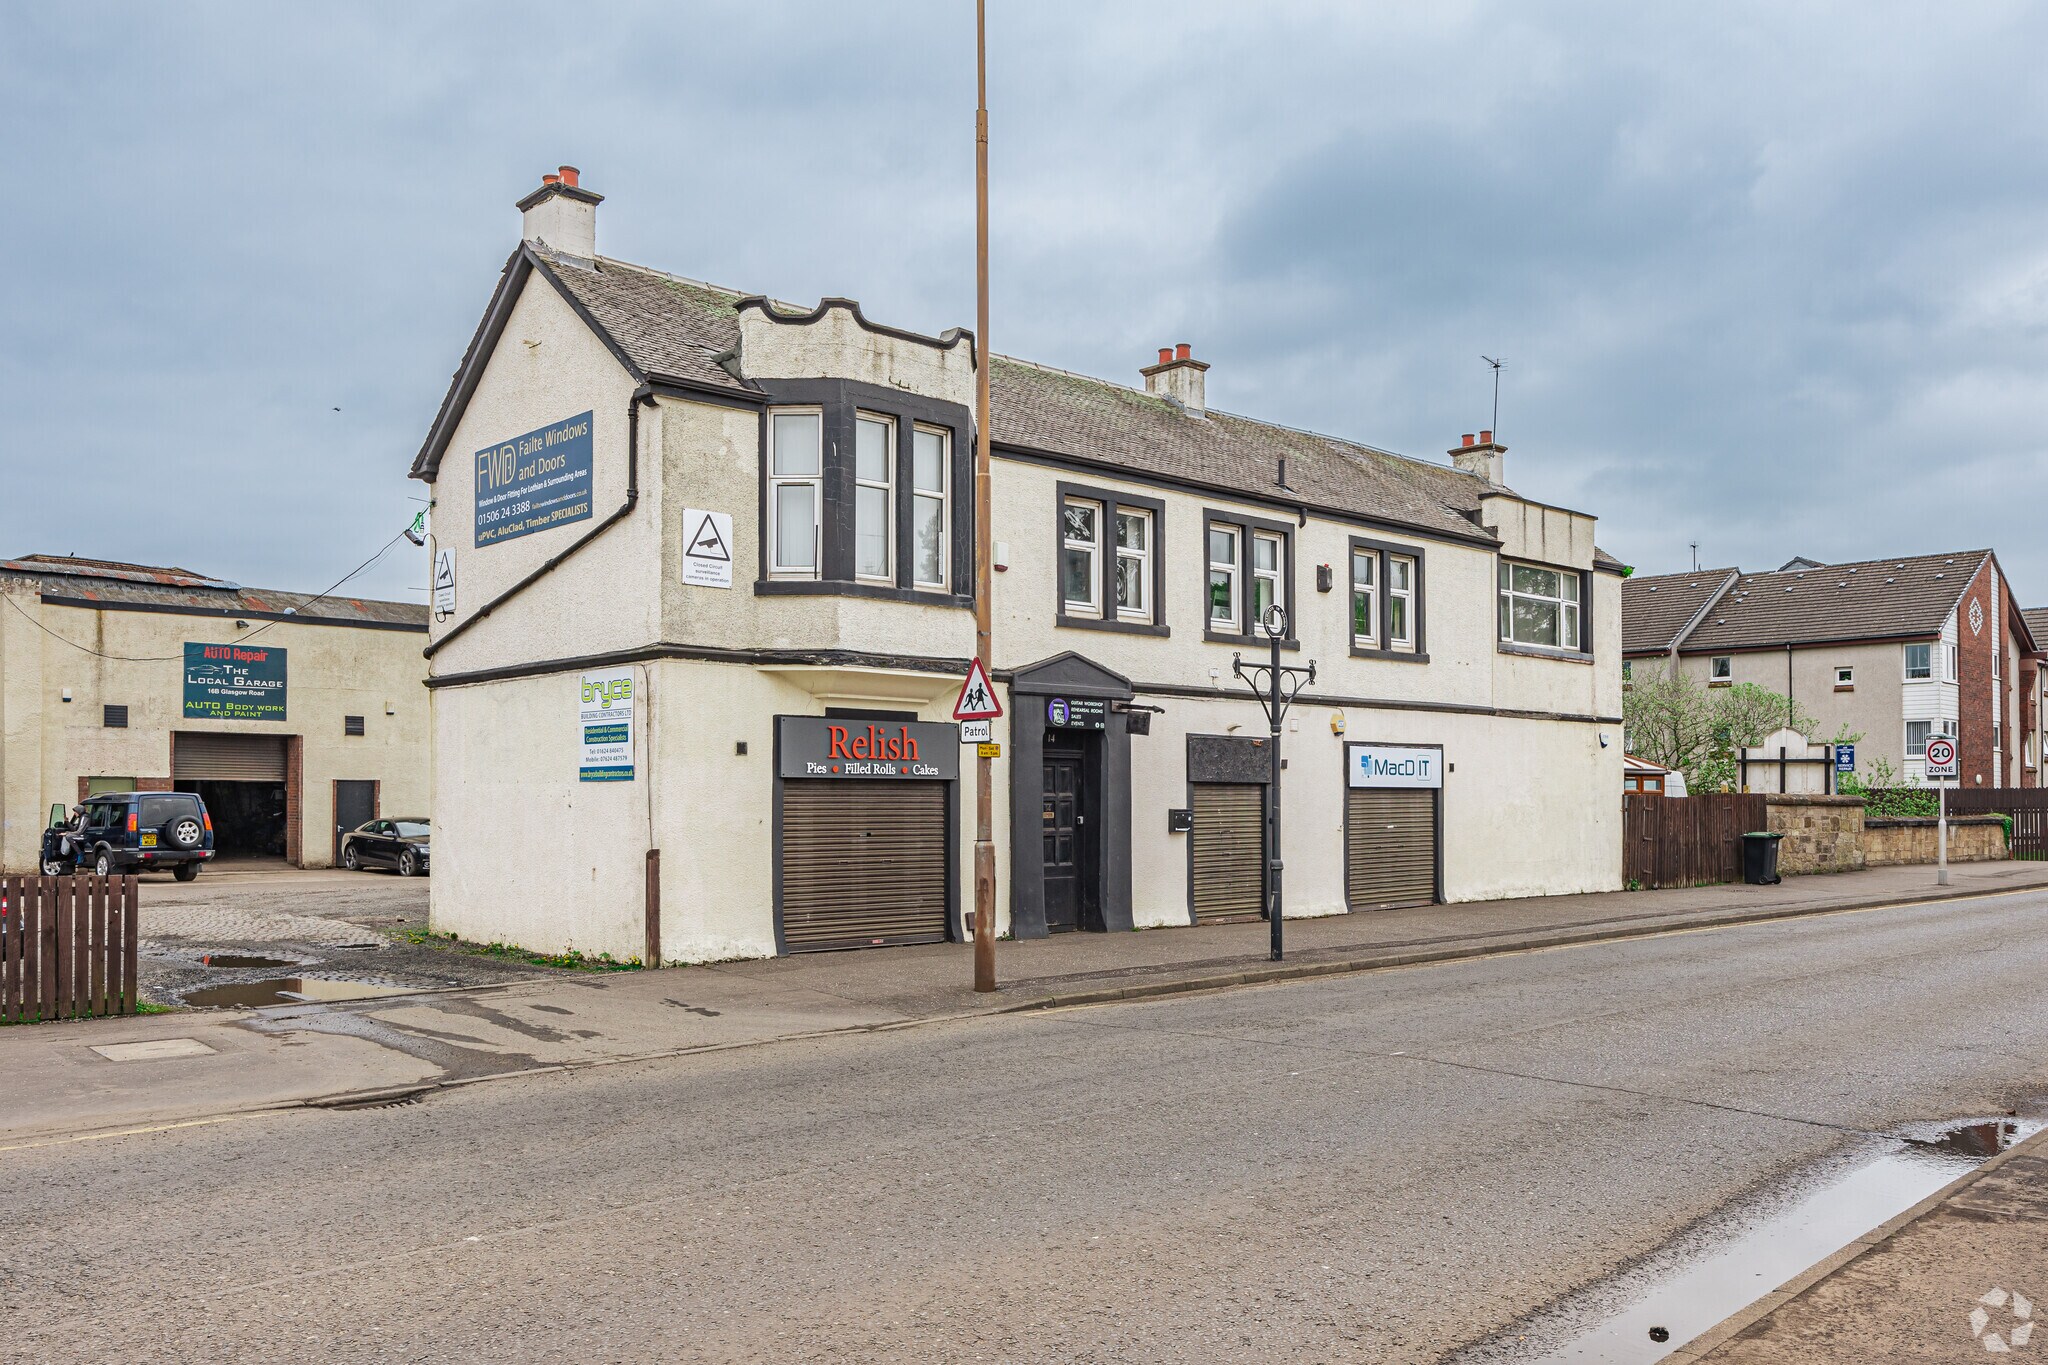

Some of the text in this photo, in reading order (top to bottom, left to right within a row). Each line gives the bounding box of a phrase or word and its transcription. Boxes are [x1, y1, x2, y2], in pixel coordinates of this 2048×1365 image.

[519, 421, 588, 457] Failte Windows
[518, 454, 566, 481] and Doors
[497, 494, 508, 502] Door
[507, 489, 521, 499] Fitting
[520, 486, 528, 494] For
[528, 482, 544, 493] Lothian
[547, 472, 575, 487] Surrounding
[574, 468, 588, 478] Areas
[478, 509, 500, 526] 01506
[501, 506, 511, 519] 24
[511, 500, 531, 516] 3388
[478, 502, 588, 542] uPVC, AluClad, Timber SPECIALISTS
[203, 646, 269, 664] AUTO Repair
[223, 665, 249, 675] THE
[187, 674, 283, 688] LOCAL GARAGE
[221, 688, 248, 696] Glasgow
[581, 676, 633, 709] bryce
[185, 701, 221, 710] AUTO
[226, 702, 254, 711] BODY
[581, 712, 598, 720] BUILDING
[598, 710, 625, 719] CONTRACTORS
[608, 734, 627, 742] Specialists
[964, 726, 988, 737] Patrol
[827, 724, 920, 761] Relish
[1932, 748, 1950, 758] 20
[806, 762, 939, 776] Pies Filled Rolls Cakes
[1374, 759, 1429, 776] MacD IT
